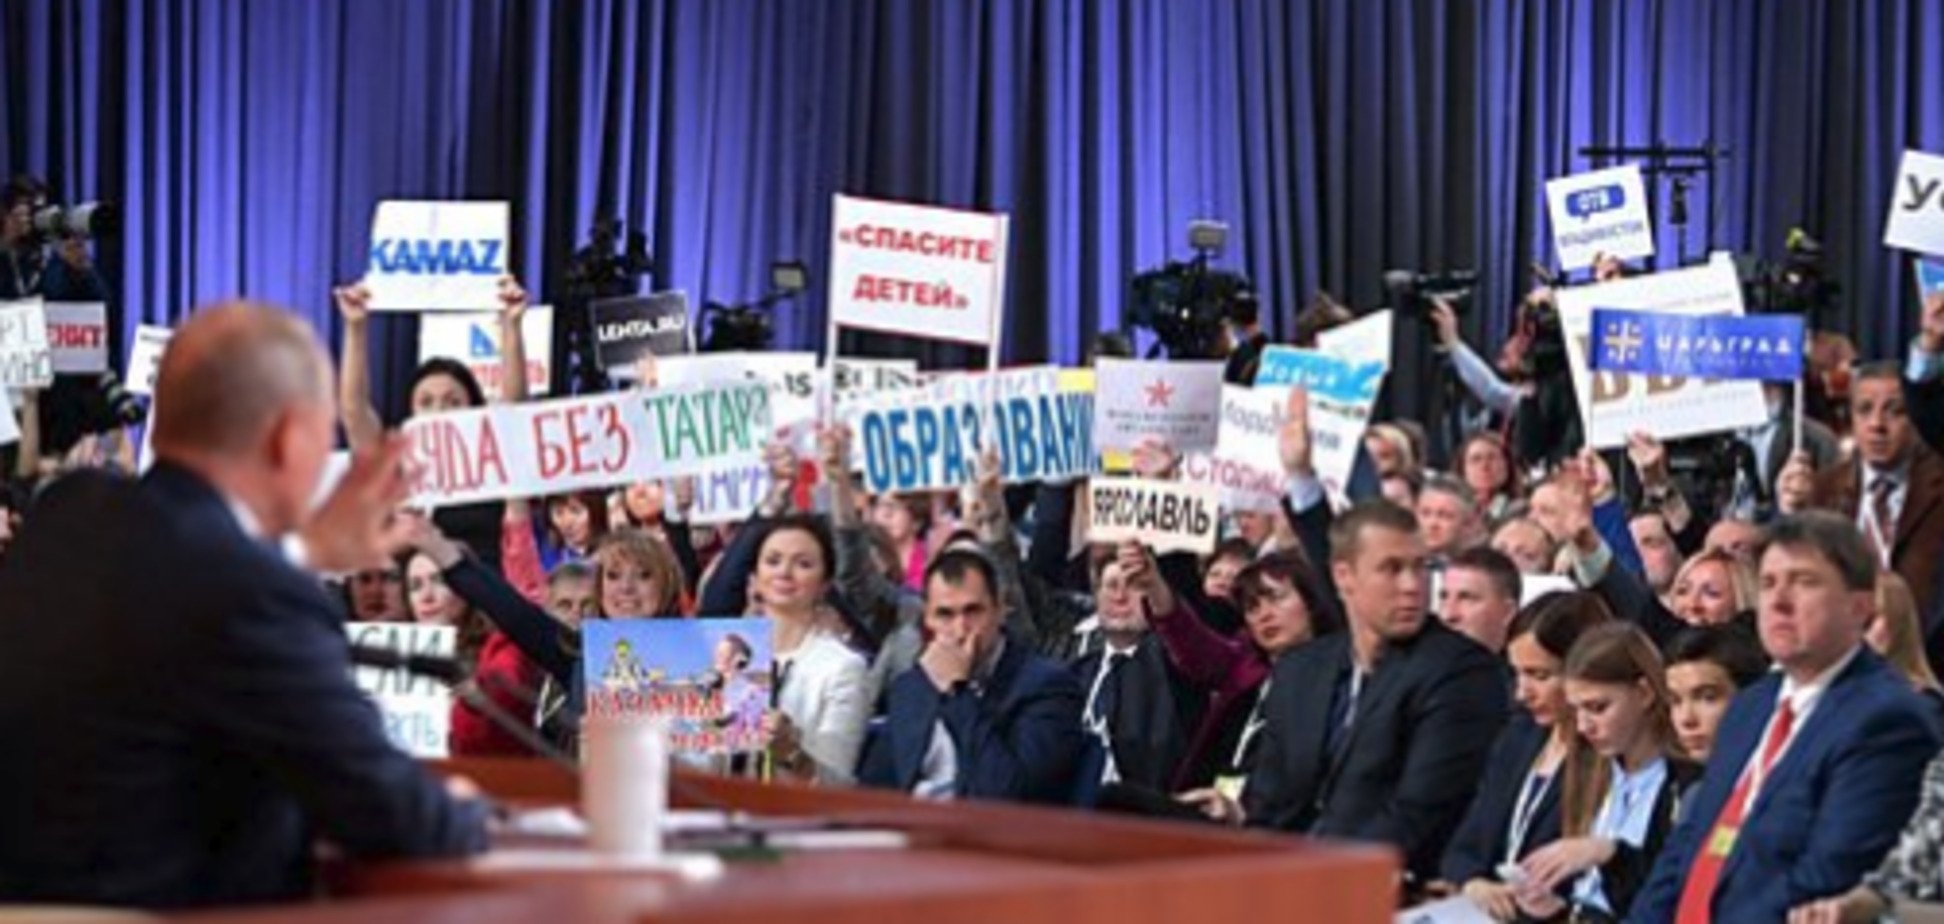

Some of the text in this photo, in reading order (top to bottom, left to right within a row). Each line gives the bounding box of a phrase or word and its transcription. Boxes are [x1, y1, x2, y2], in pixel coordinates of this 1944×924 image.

[838, 223, 994, 264] «СПАСИТЕ
[853, 274, 969, 310] ДЕТЕЙ»
[533, 402, 632, 479] БЕЗ
